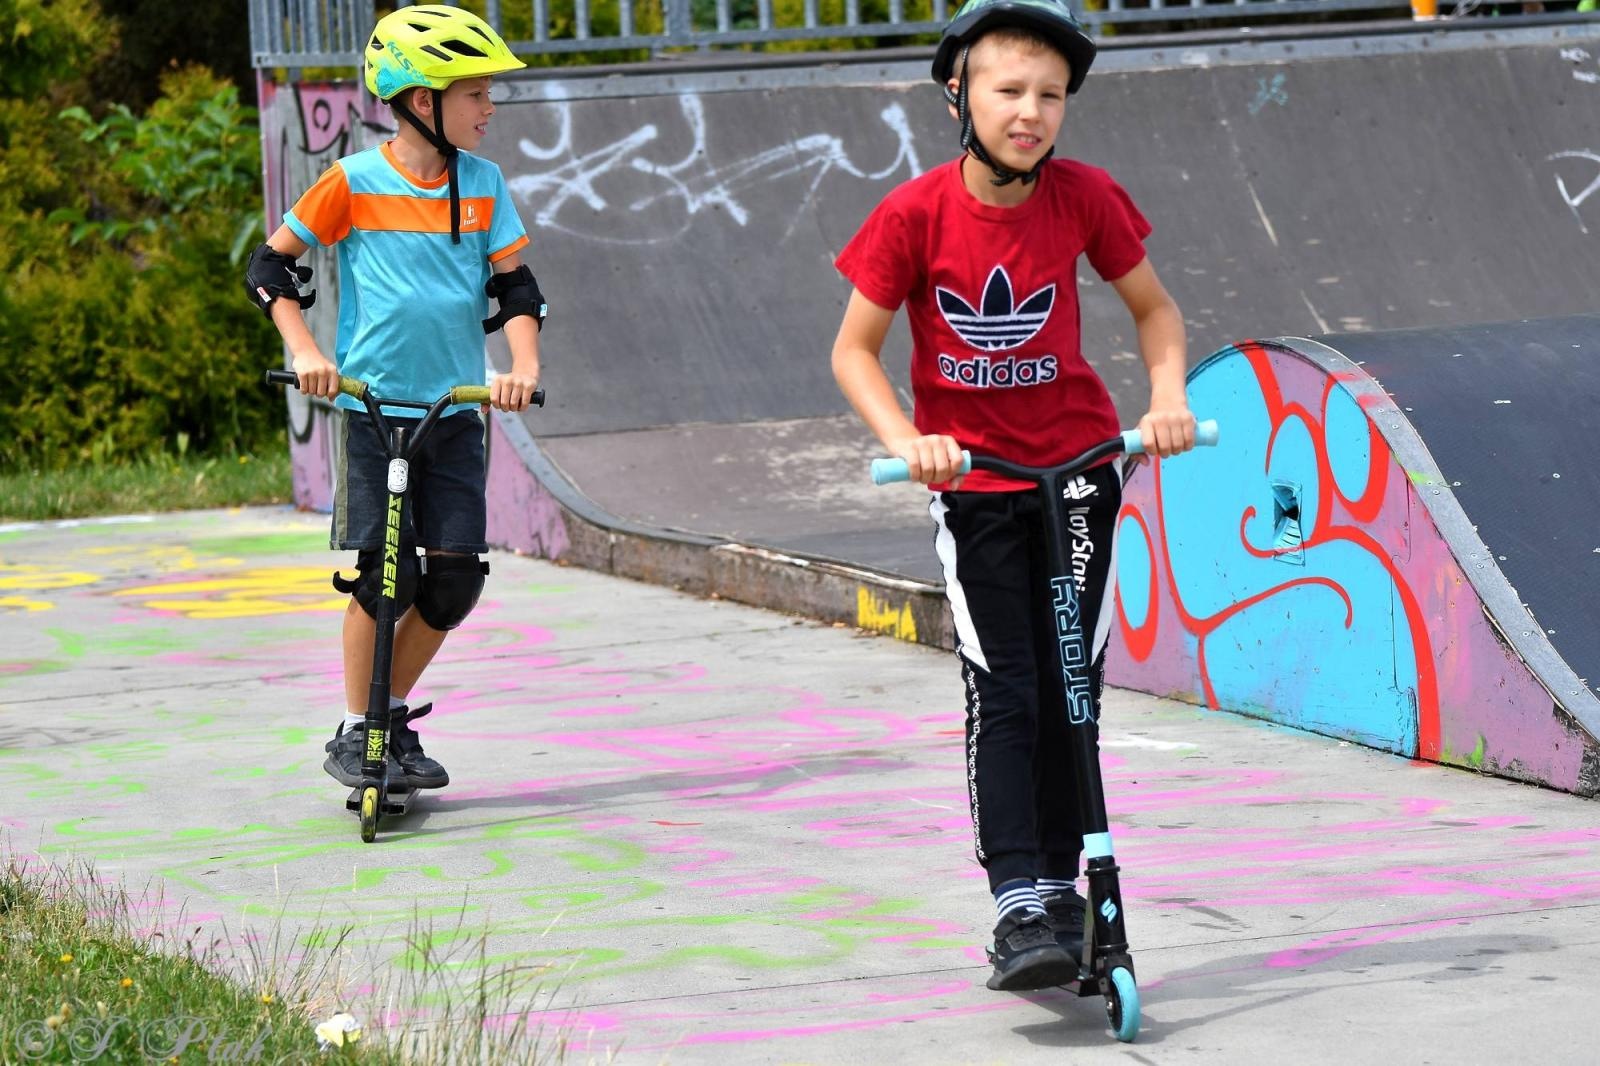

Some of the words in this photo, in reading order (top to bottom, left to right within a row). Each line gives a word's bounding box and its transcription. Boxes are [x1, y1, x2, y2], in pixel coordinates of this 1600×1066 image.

[938, 352, 1058, 388] adidas
[381, 493, 403, 599] SEEKER
[1050, 576, 1095, 724] STORY
